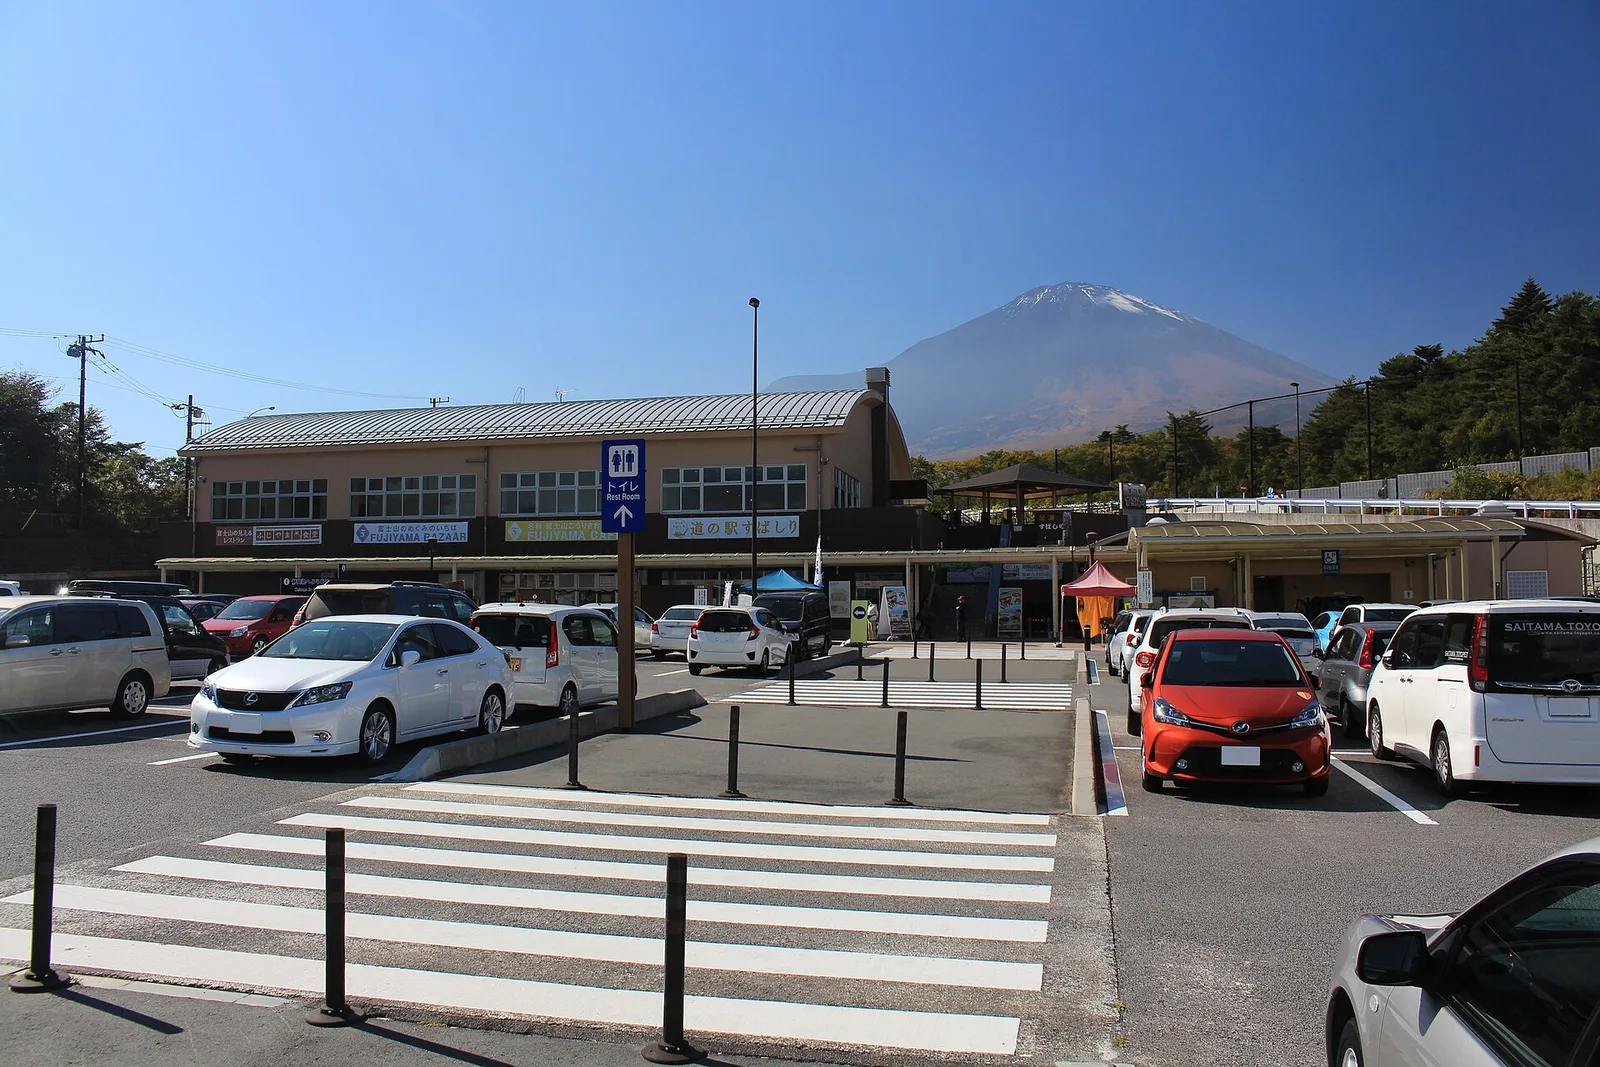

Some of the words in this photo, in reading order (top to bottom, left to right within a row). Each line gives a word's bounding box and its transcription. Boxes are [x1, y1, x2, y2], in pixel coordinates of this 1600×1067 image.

[608, 481, 639, 492] トイレ
[606, 493, 621, 501] Rest
[621, 493, 641, 501] Room
[690, 520, 797, 536] 道の駅すばしり
[217, 529, 252, 537] 富士山の見える
[370, 533, 420, 542] FUJIYAMA
[527, 531, 586, 540] FUJIYAMA
[1504, 623, 1563, 631] SAITAMA
[1566, 622, 1600, 631] TOYO
